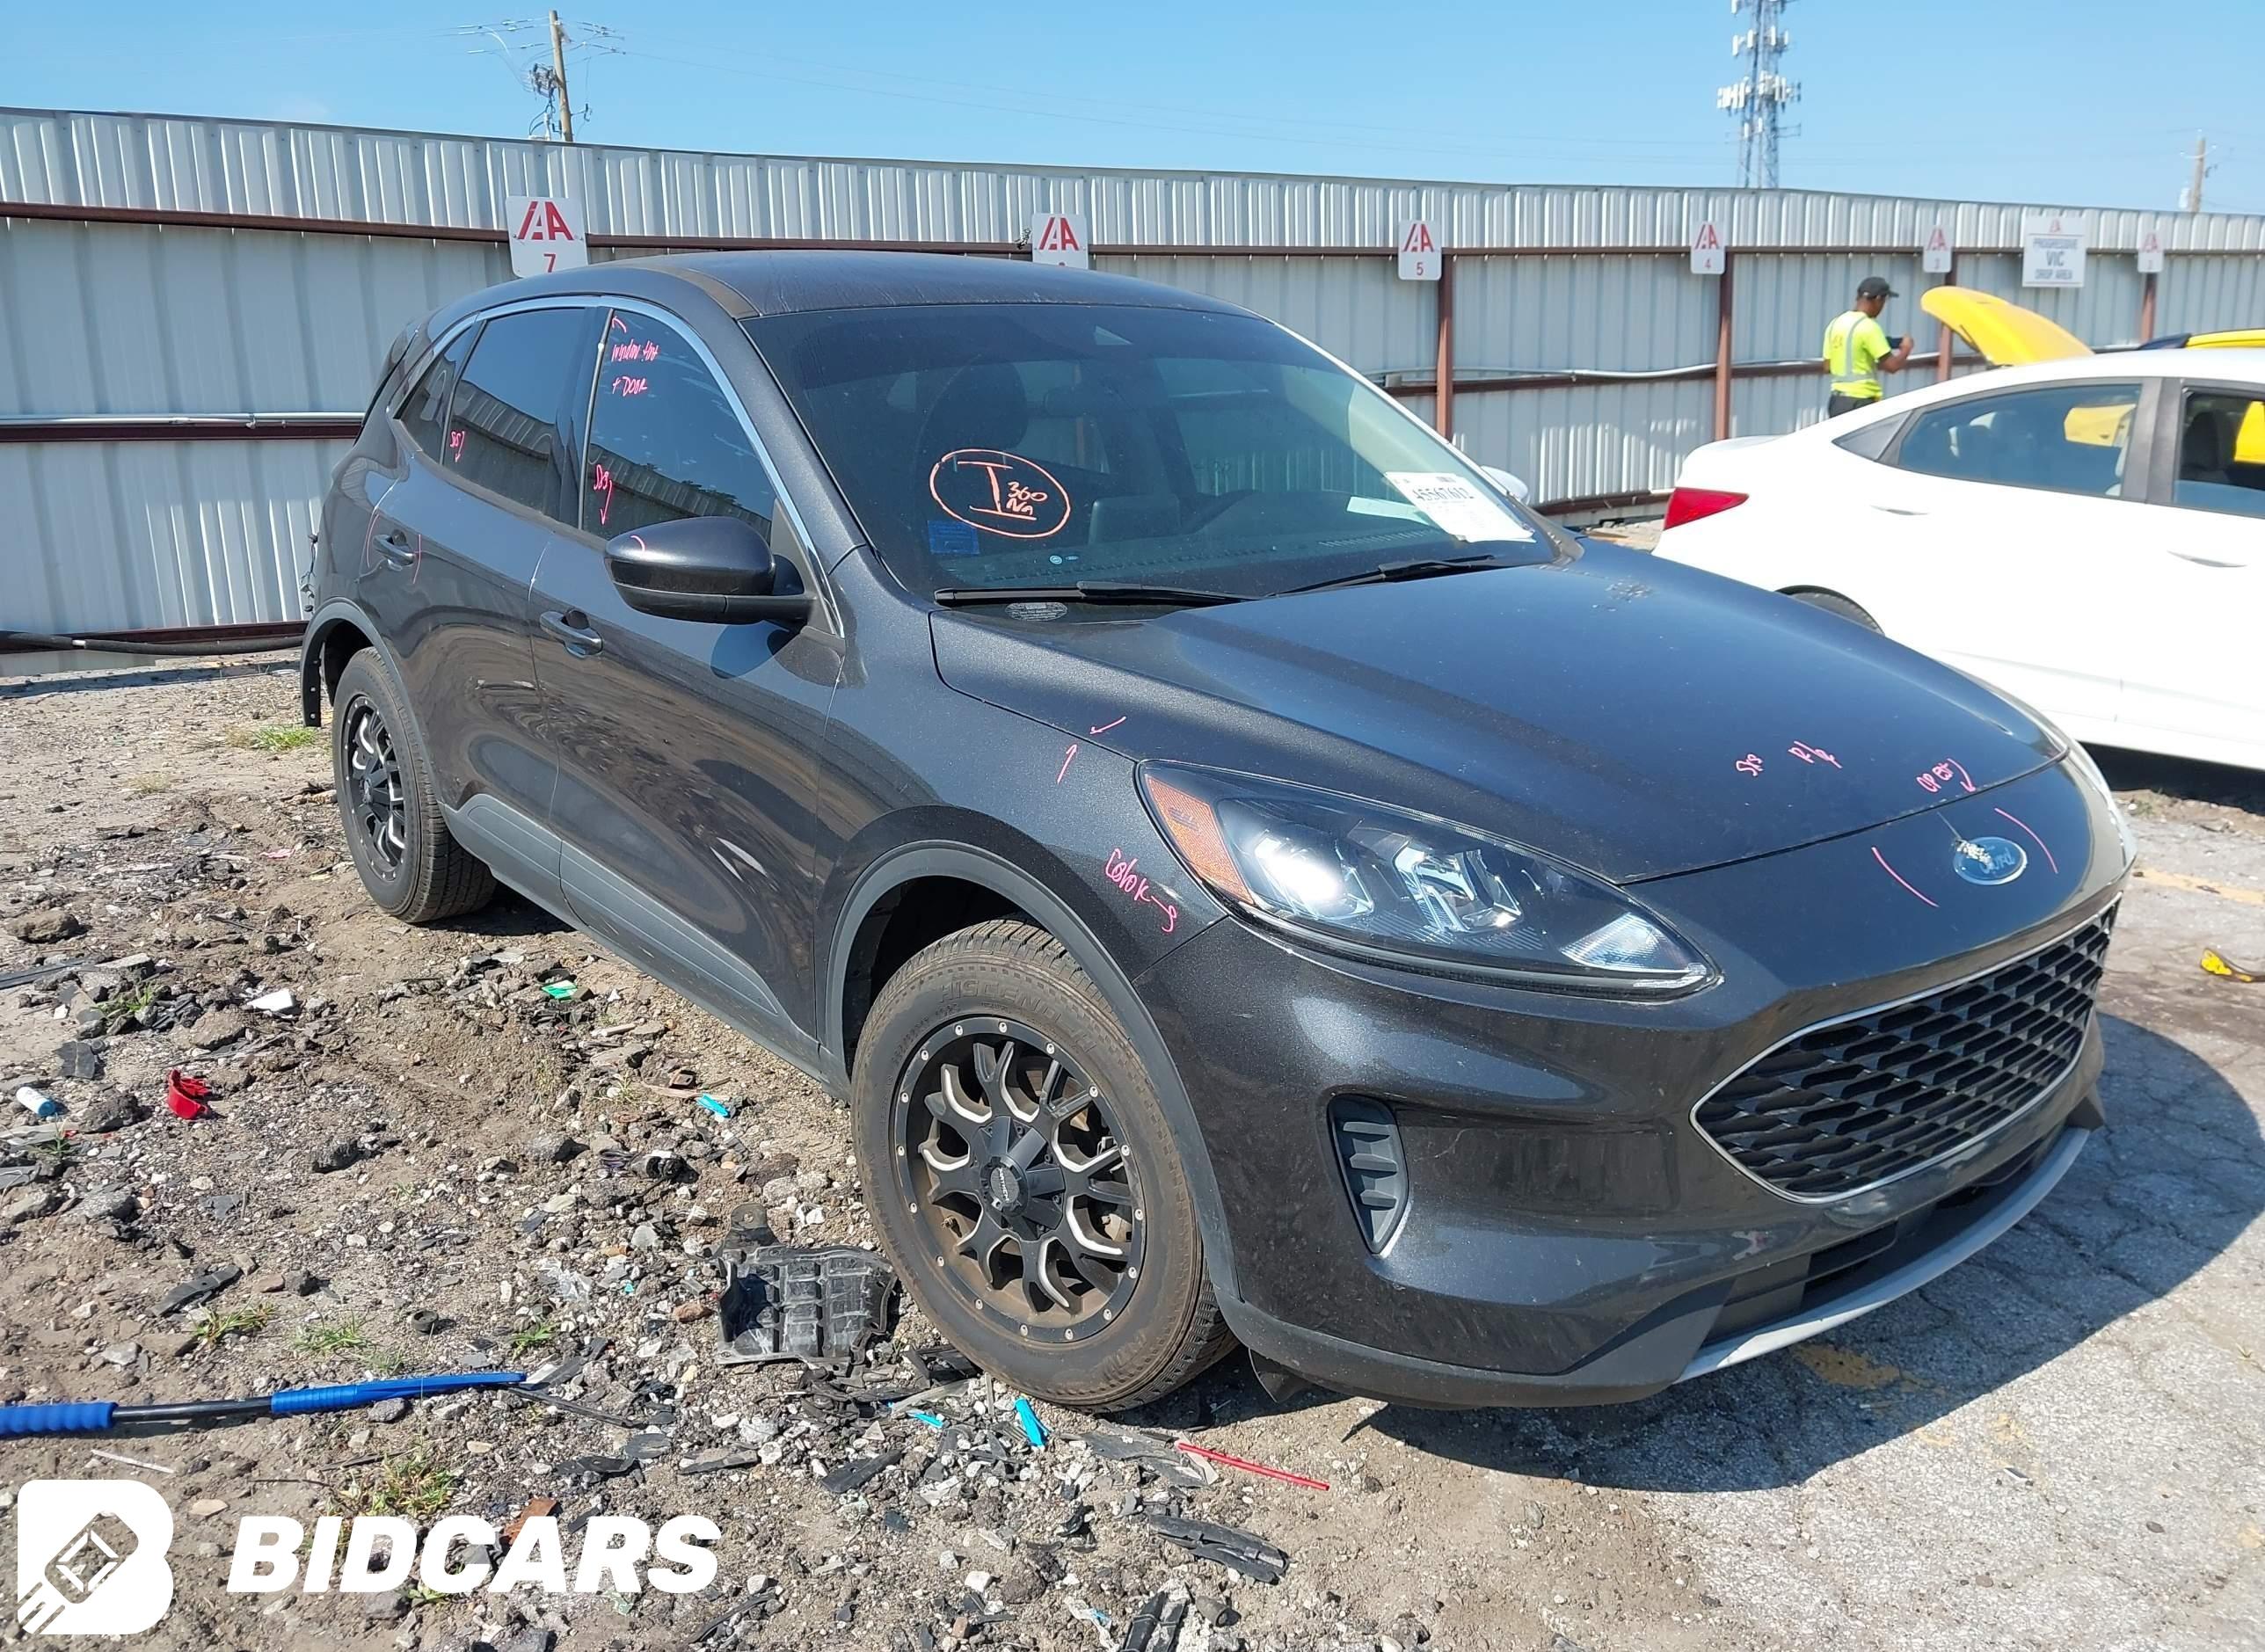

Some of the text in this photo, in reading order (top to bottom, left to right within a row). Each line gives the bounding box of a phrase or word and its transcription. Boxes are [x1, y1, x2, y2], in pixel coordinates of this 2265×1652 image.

[543, 253, 556, 273] 7
[1704, 258, 1712, 270] 4
[2046, 251, 2065, 266] VIC
[1416, 262, 1424, 276] 5
[1008, 481, 1049, 502] 360
